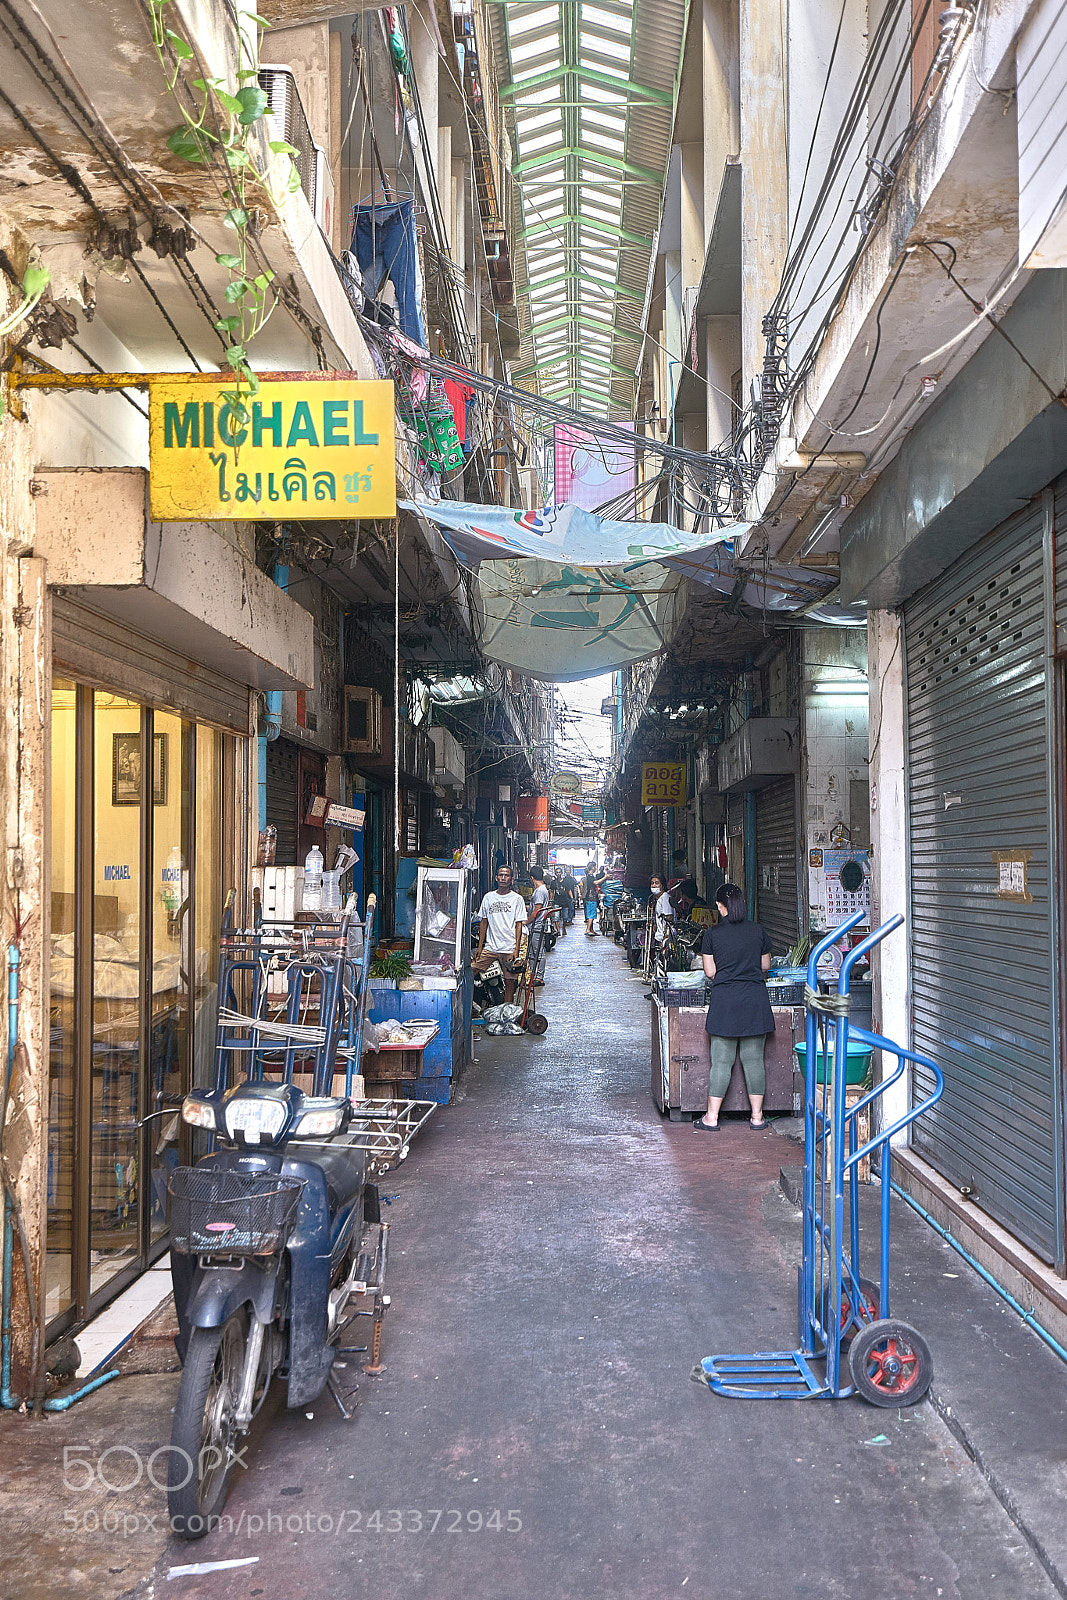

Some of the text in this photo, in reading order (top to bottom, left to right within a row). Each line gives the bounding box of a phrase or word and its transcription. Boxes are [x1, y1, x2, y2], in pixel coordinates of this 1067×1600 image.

[164, 400, 379, 448] MICHAEL
[209, 452, 336, 502] ไมเคิล
[104, 866, 130, 880] MICHAEL
